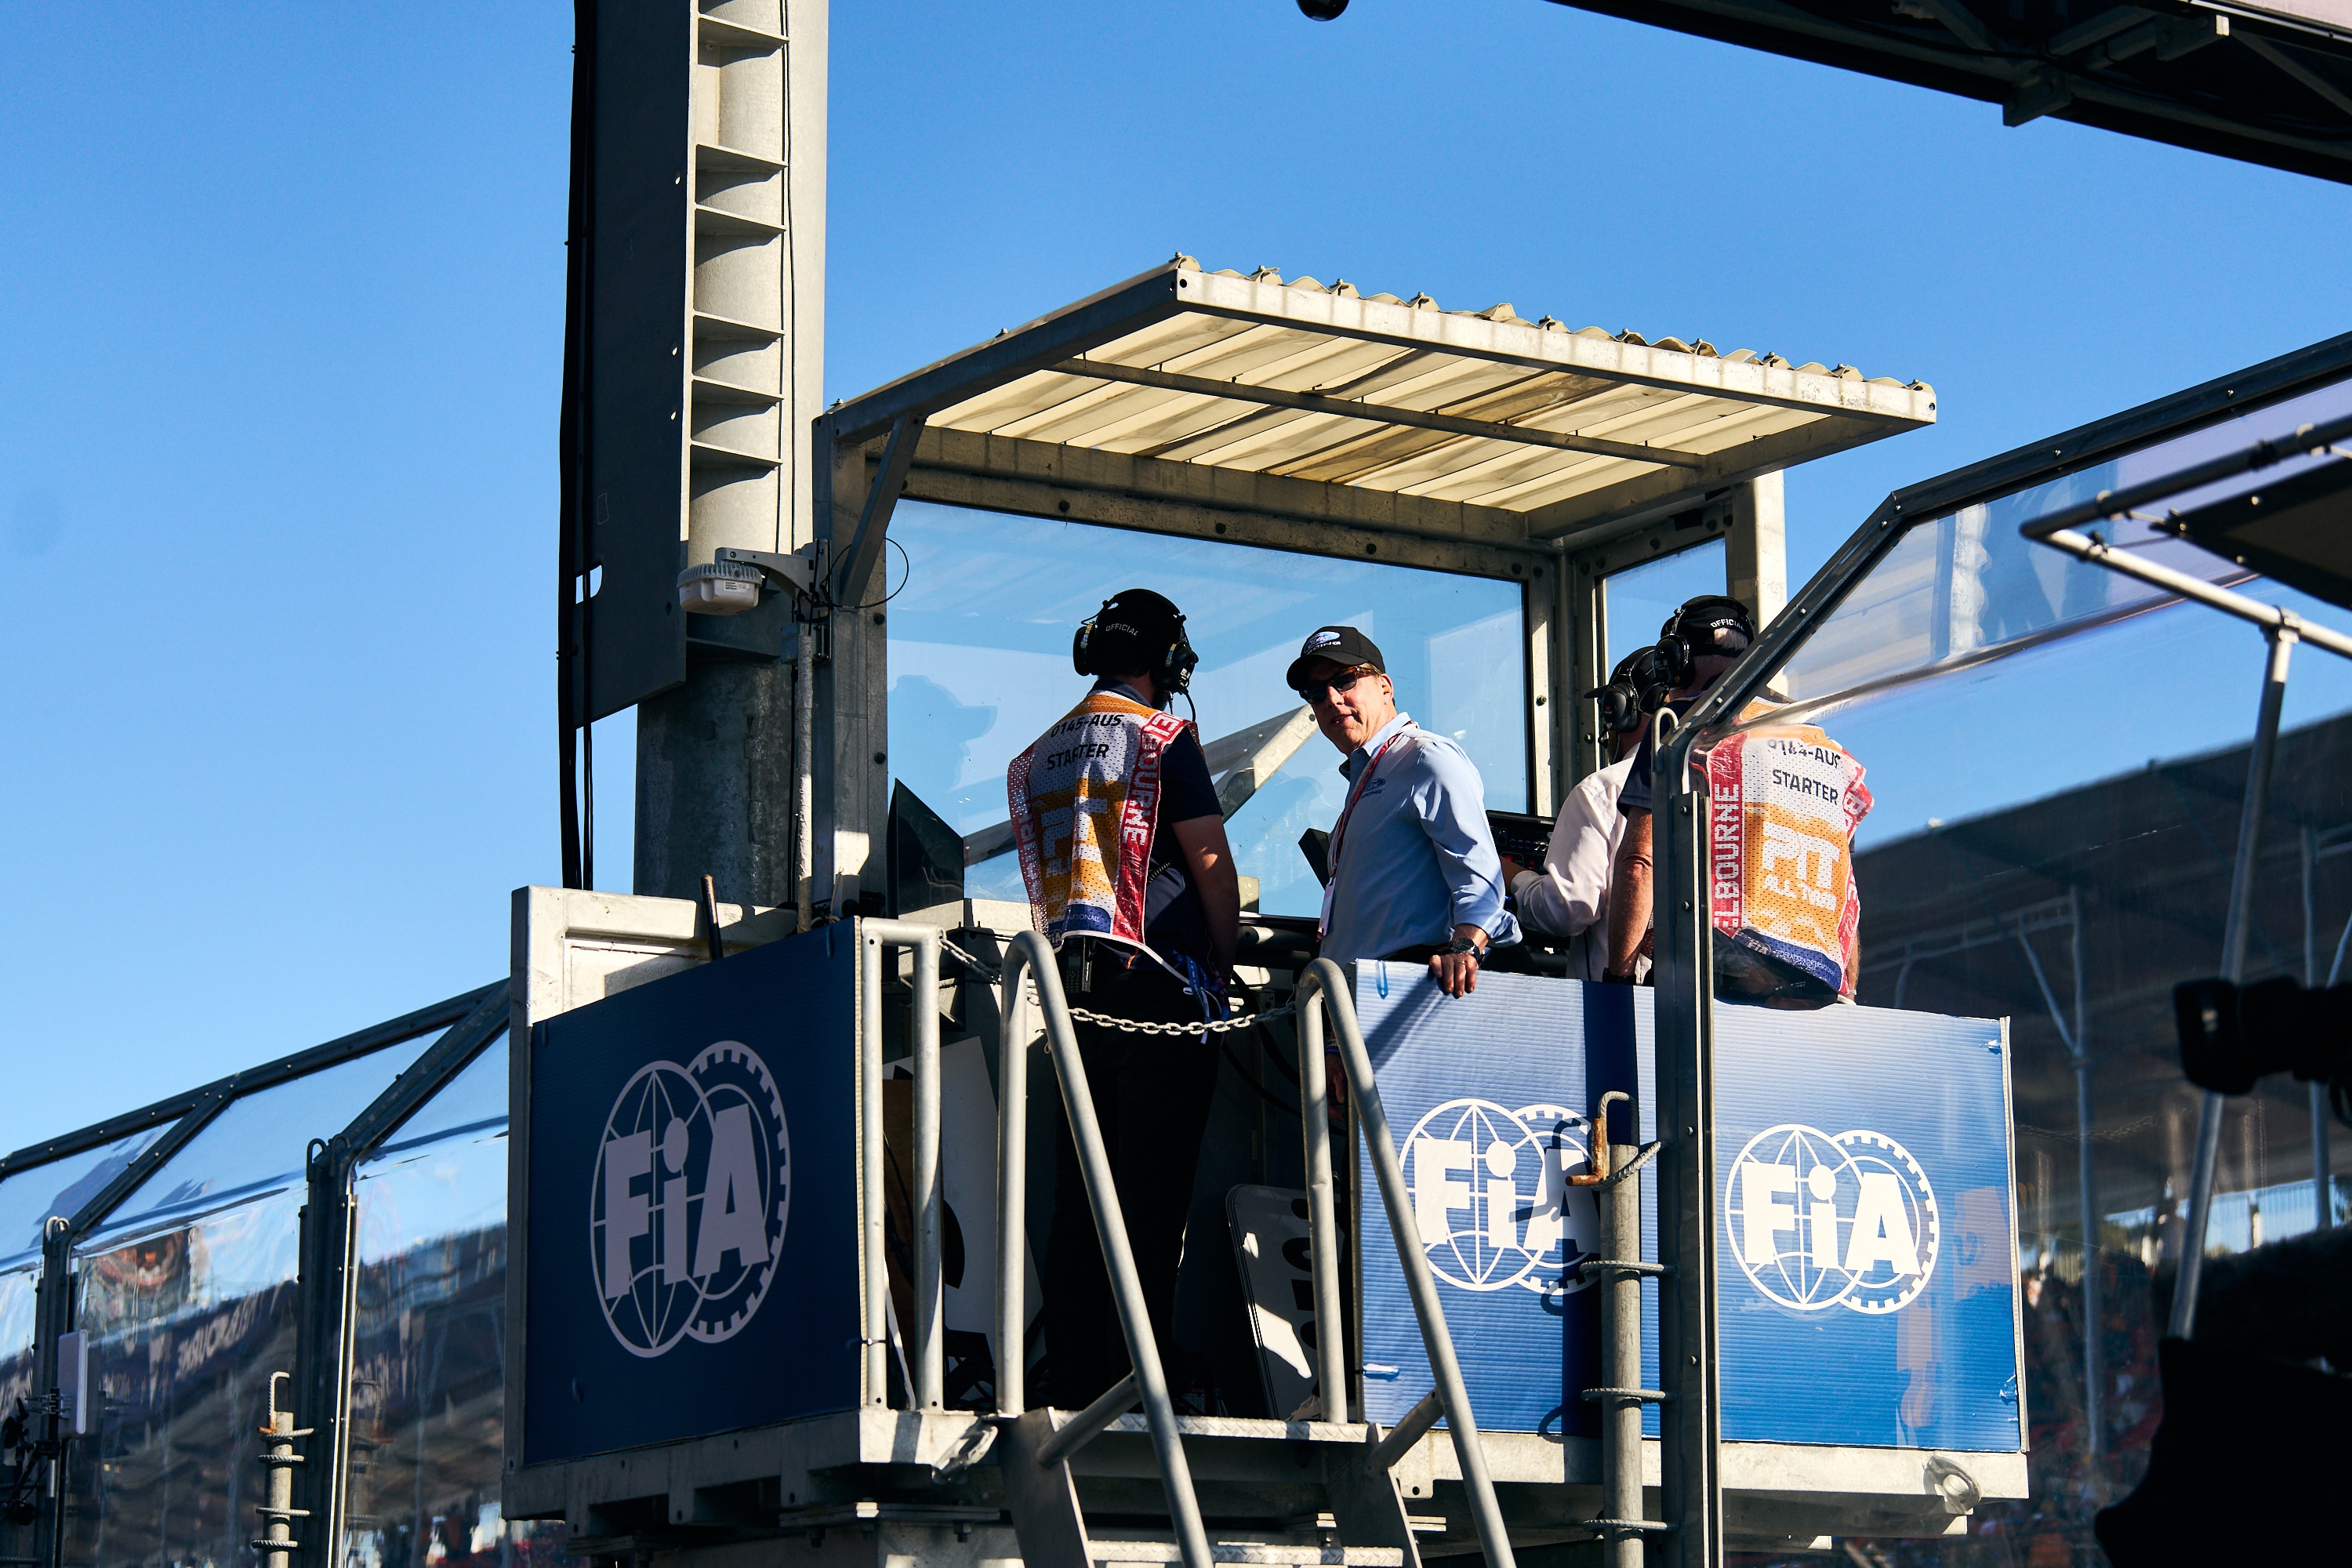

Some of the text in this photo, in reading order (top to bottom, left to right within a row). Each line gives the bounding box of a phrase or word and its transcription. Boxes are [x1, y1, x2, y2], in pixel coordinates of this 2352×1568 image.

[1105, 622, 1139, 636] OFFICIAL
[1710, 618, 1745, 632] OFFICIAL
[1051, 714, 1125, 738] 0145-AUS
[1047, 743, 1109, 771] STARTER
[1772, 768, 1839, 806] STARTER
[1714, 783, 1740, 928] ELBOURNE
